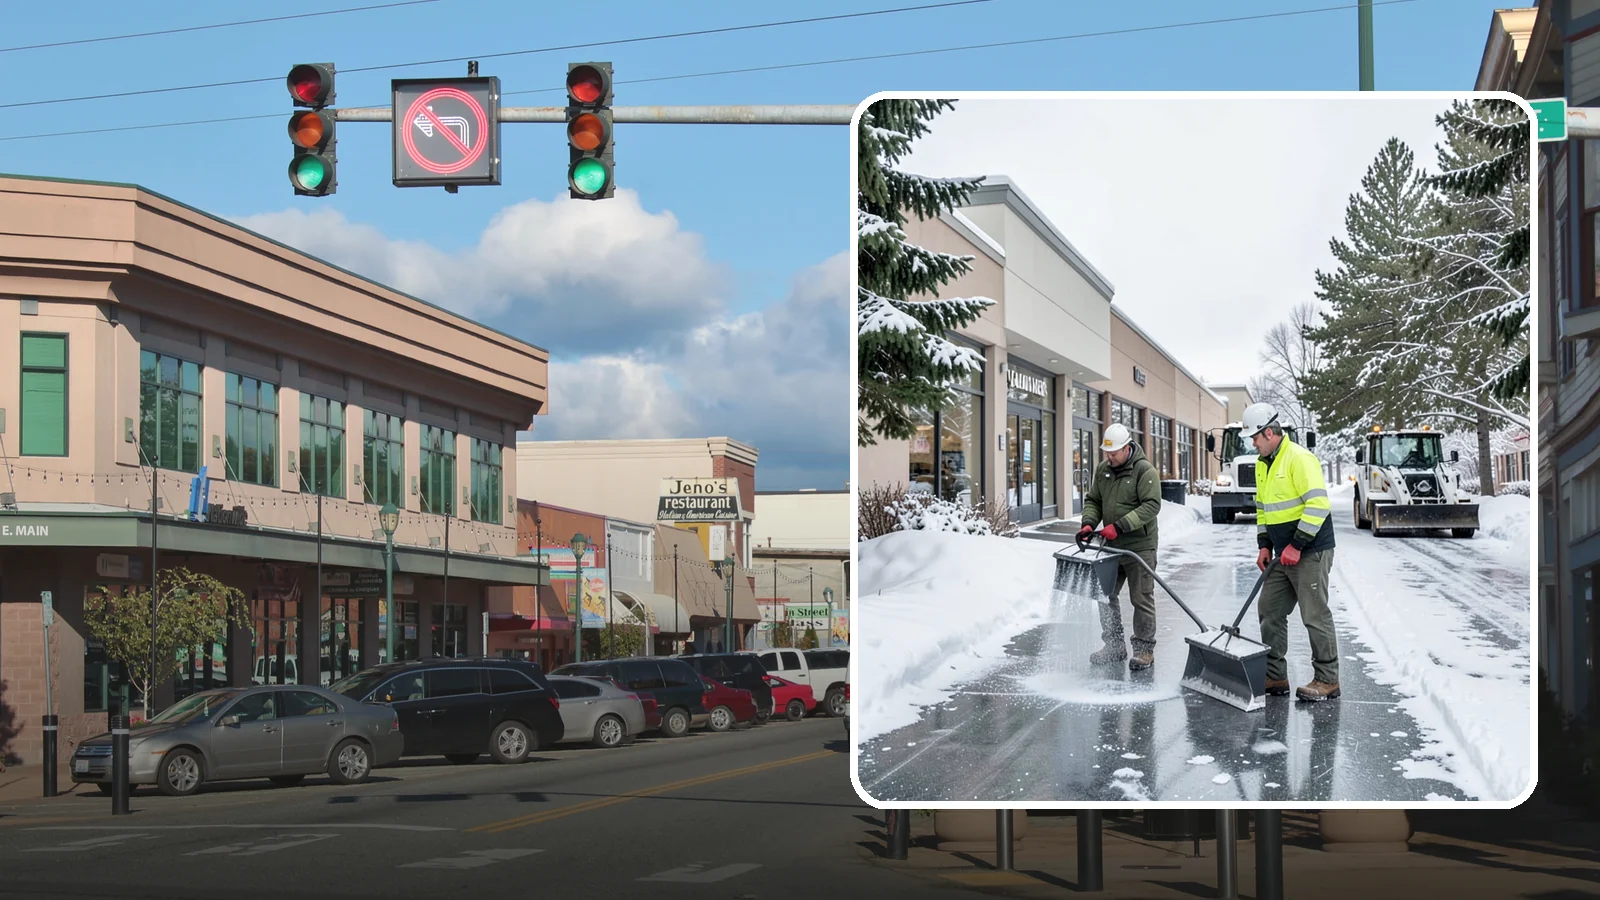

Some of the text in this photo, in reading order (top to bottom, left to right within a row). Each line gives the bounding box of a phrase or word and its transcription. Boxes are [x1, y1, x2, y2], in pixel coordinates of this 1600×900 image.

[669, 480, 727, 495] Jeno's
[665, 496, 731, 509] restaurant
[658, 510, 682, 519] Italian
[686, 509, 715, 519] American
[715, 509, 737, 519] Cuisine
[2, 525, 49, 536] E. MAIN
[797, 607, 828, 617] Street
[791, 619, 823, 627] lass
